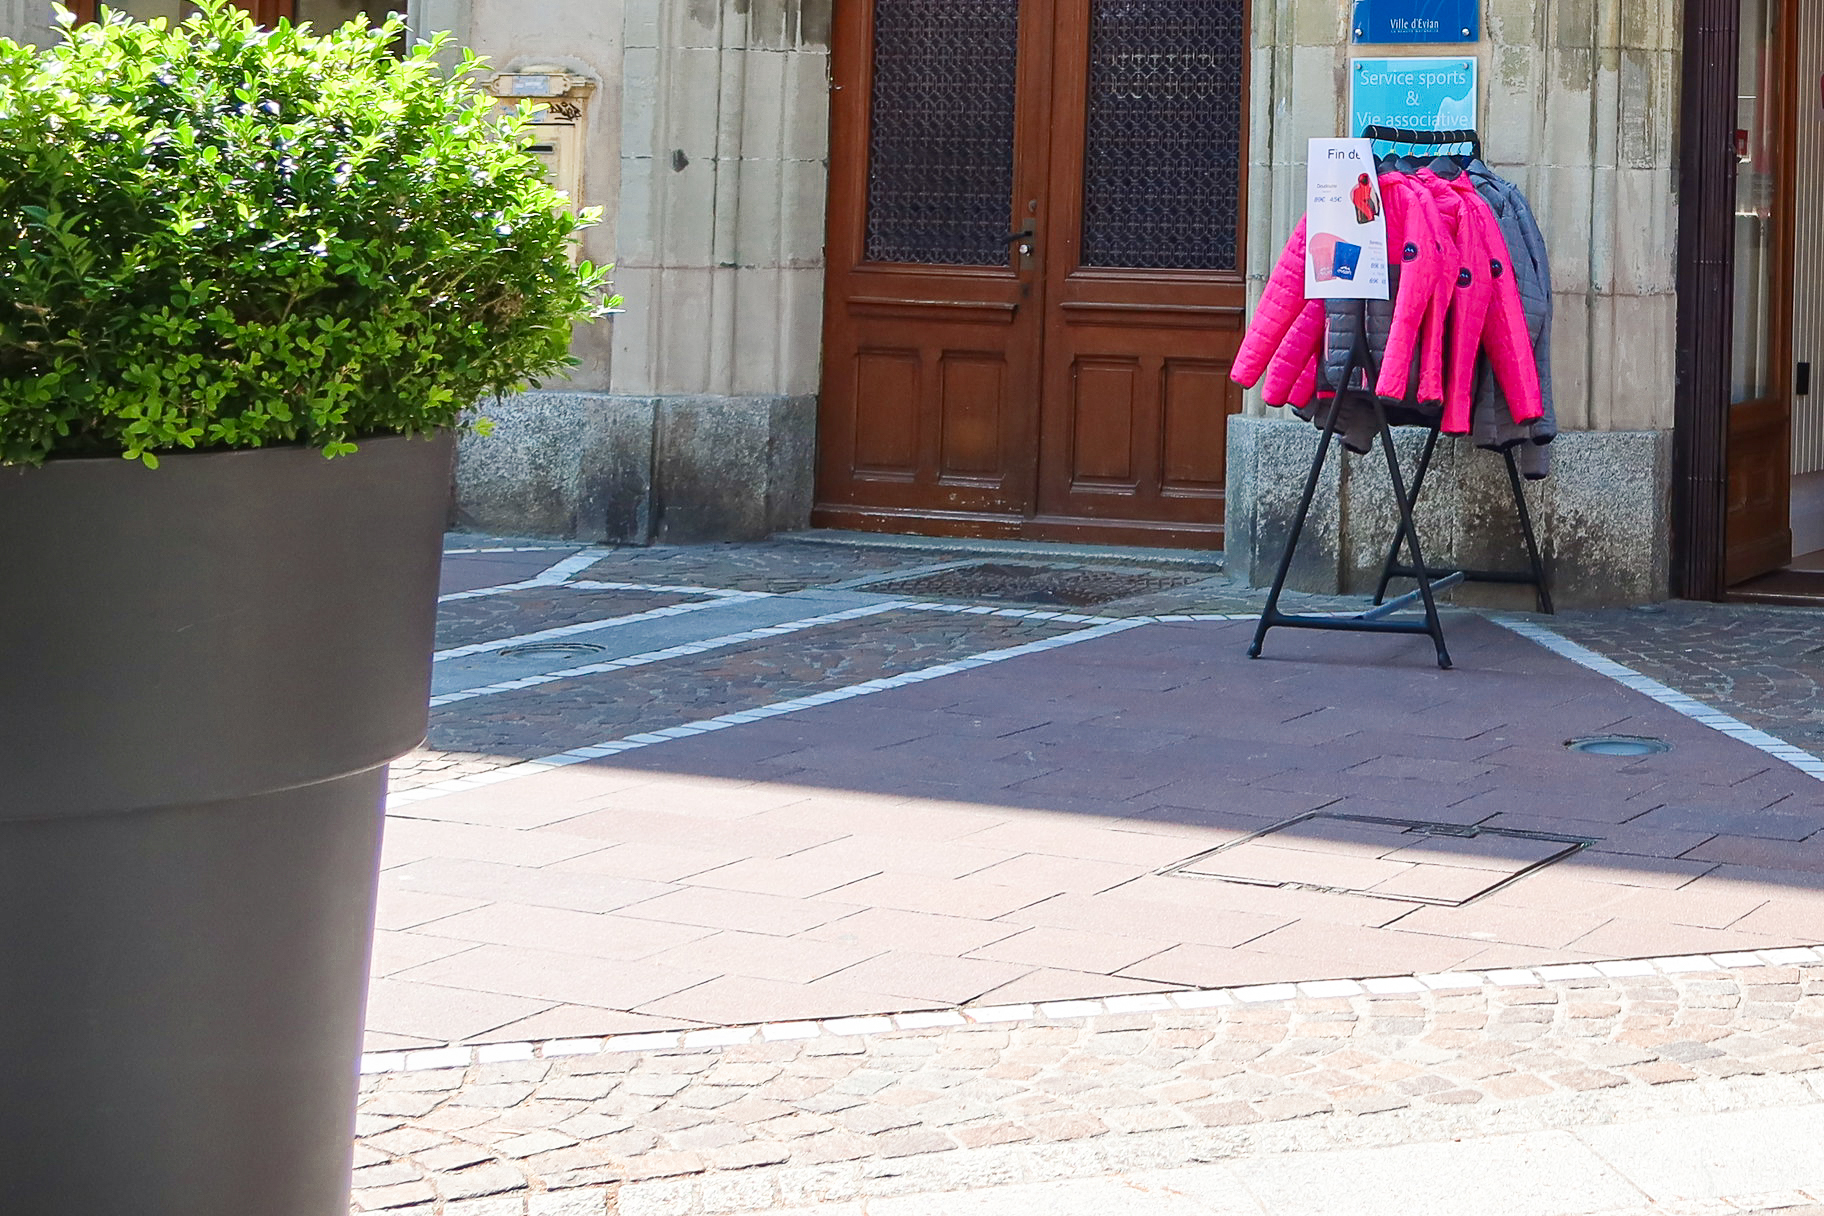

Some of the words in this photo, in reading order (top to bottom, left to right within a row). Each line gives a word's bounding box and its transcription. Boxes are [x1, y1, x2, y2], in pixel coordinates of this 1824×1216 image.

[1390, 17, 1409, 29] Ville
[1360, 69, 1414, 86] Service
[1418, 70, 1467, 89] sports
[1405, 90, 1420, 106] &
[1356, 110, 1381, 127] Vie
[1385, 111, 1470, 127] associative
[1327, 148, 1345, 160] Fin
